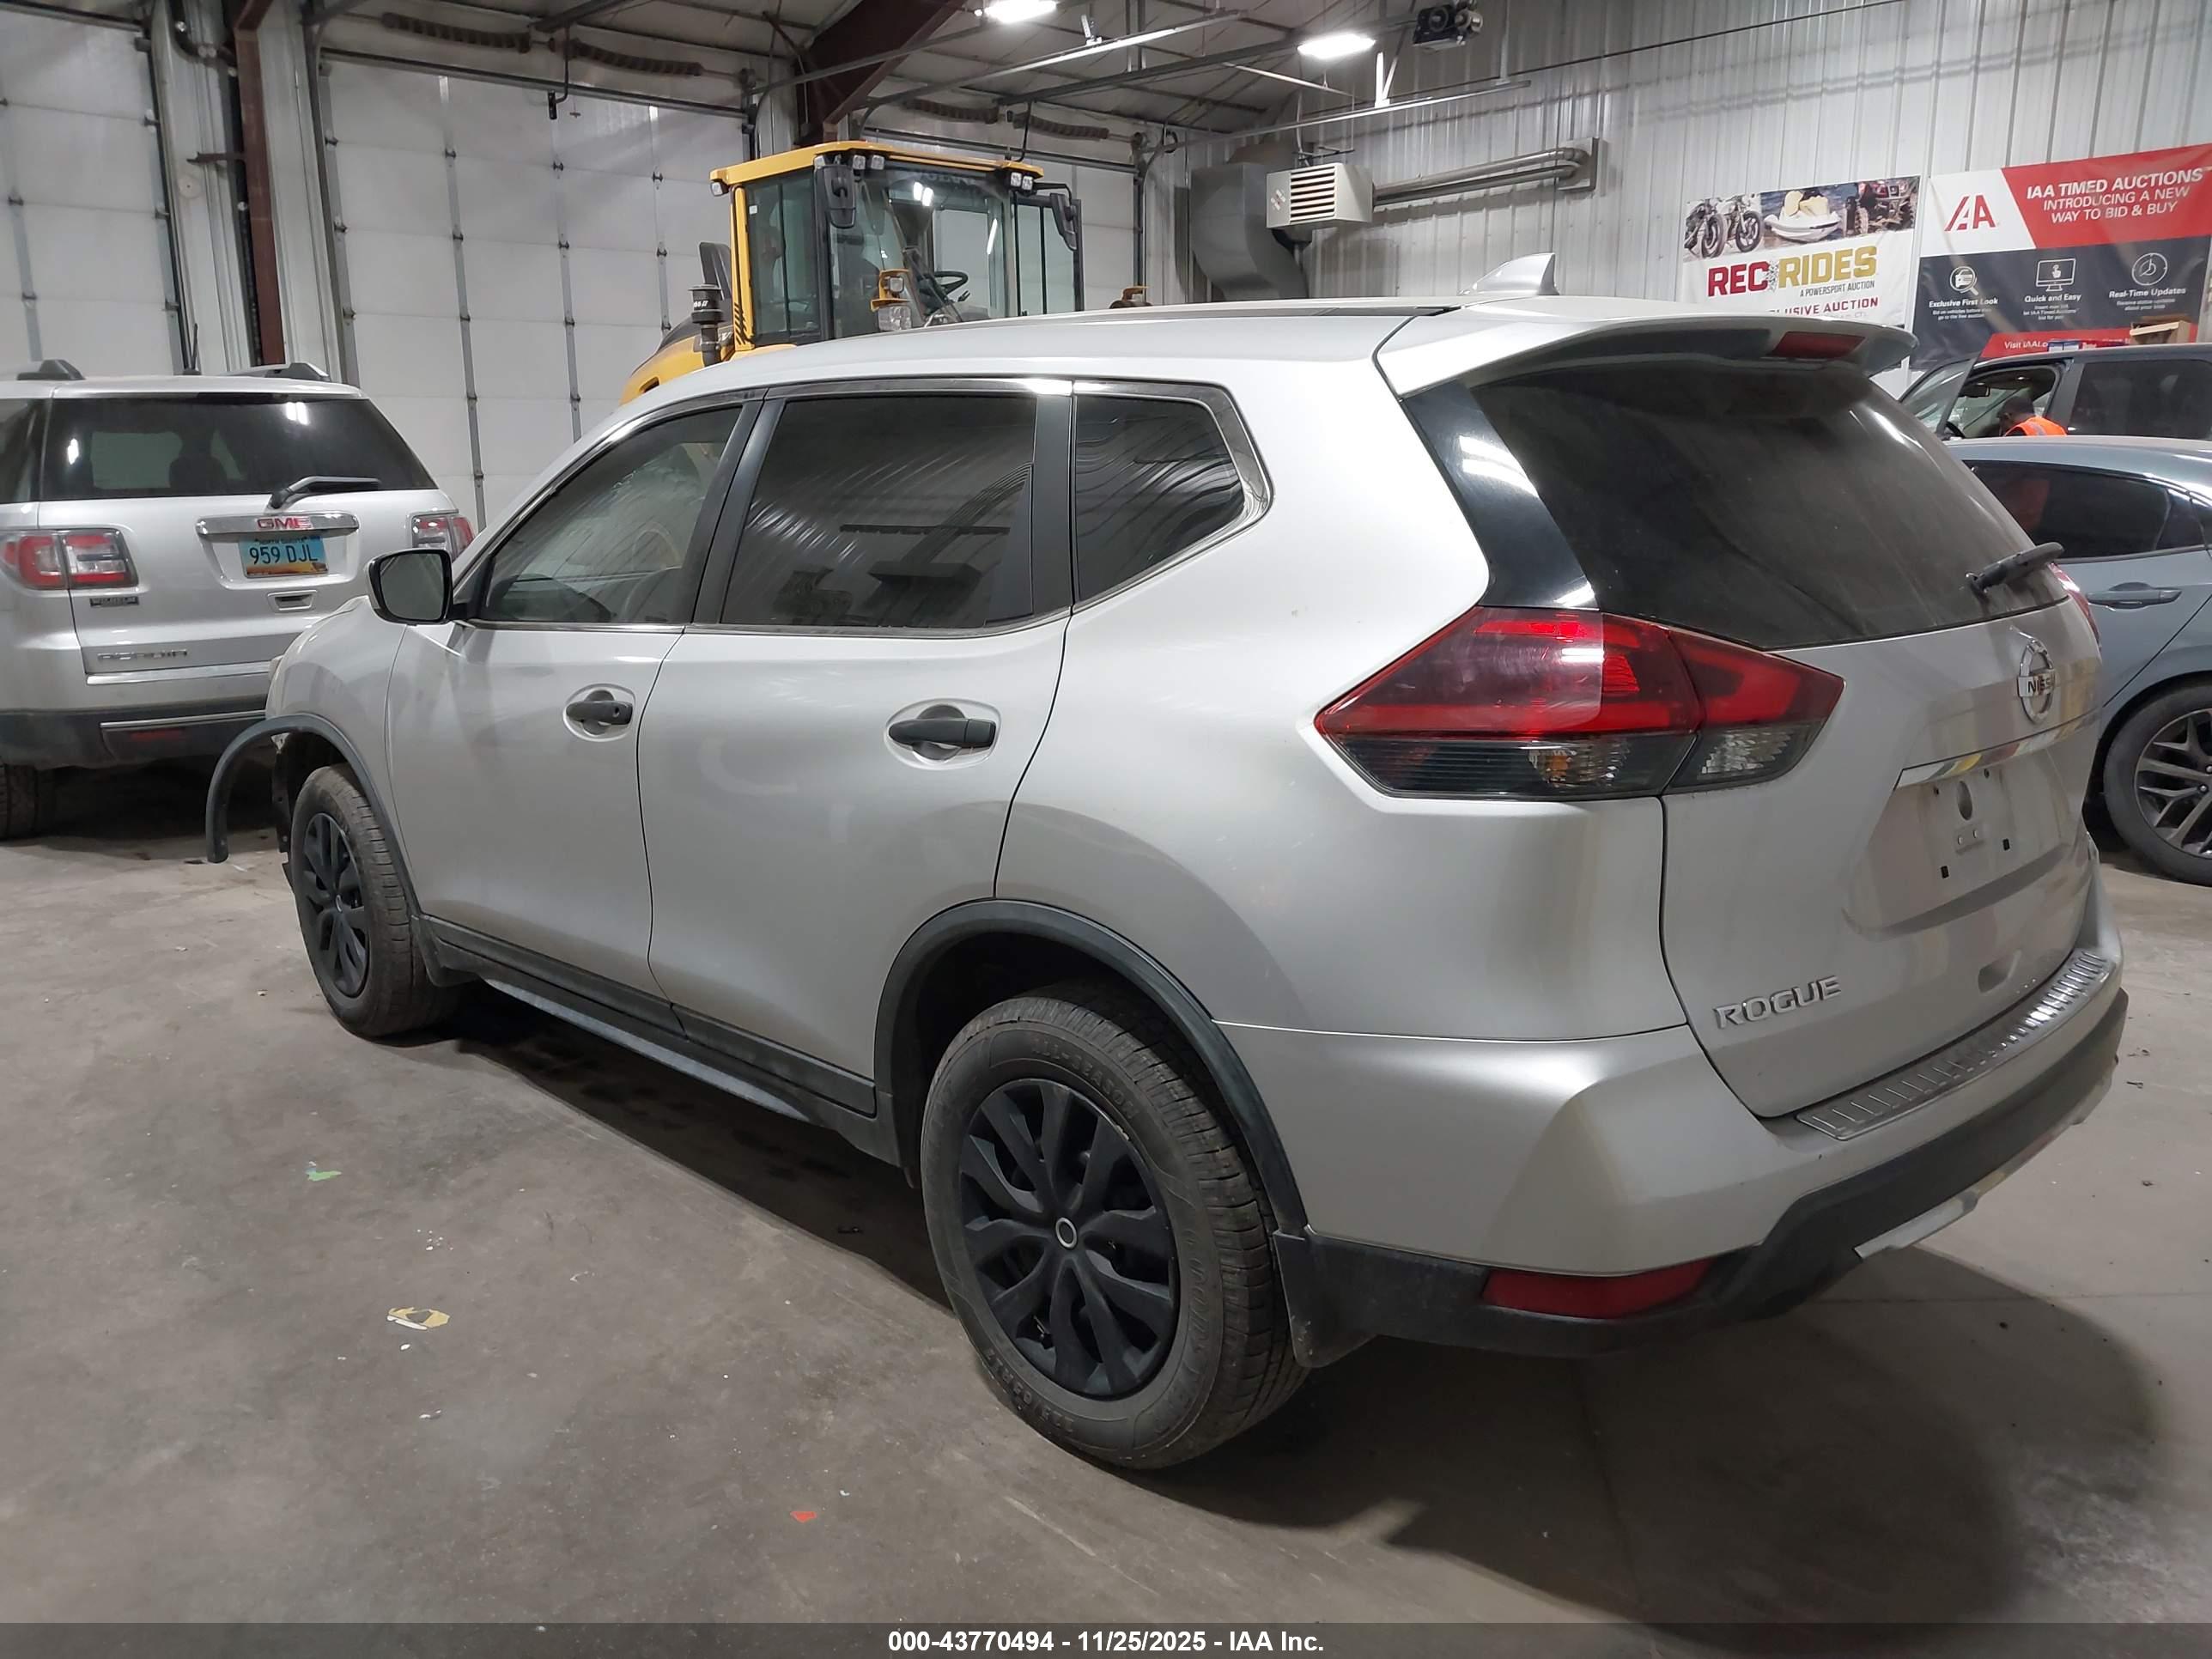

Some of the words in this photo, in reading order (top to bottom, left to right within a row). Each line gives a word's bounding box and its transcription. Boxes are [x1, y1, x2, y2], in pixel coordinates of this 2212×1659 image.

[2027, 185, 2055, 200] IAA
[2058, 179, 2108, 197] TIMED
[2112, 167, 2203, 192] AUCTIONS
[2044, 191, 2136, 211] INTRODUCING
[2140, 190, 2151, 201] A
[2154, 185, 2191, 200] NEW
[2051, 210, 2080, 224] WAY
[2083, 208, 2102, 221] TO
[2105, 206, 2129, 219] BID
[2131, 204, 2143, 216] &
[2147, 200, 2179, 215] BUY
[1708, 260, 1770, 297] REC
[1778, 246, 1878, 289] RIDES
[1800, 289, 1805, 298] A
[1805, 283, 1845, 297] POWERSPORT
[1847, 280, 1876, 291] AUCTION
[2024, 295, 2047, 303] Quick
[2048, 294, 2063, 302] and
[2063, 293, 2082, 302] Easy
[2109, 289, 2149, 299] Real-Time
[2150, 287, 2187, 297] Updates
[1823, 296, 1879, 313] AUCTION
[1929, 300, 1961, 308] Exclusive
[1962, 298, 1978, 307] First
[249, 545, 281, 565] 959
[286, 544, 319, 564] DJL
[1713, 973, 1842, 1030] ROGUE
